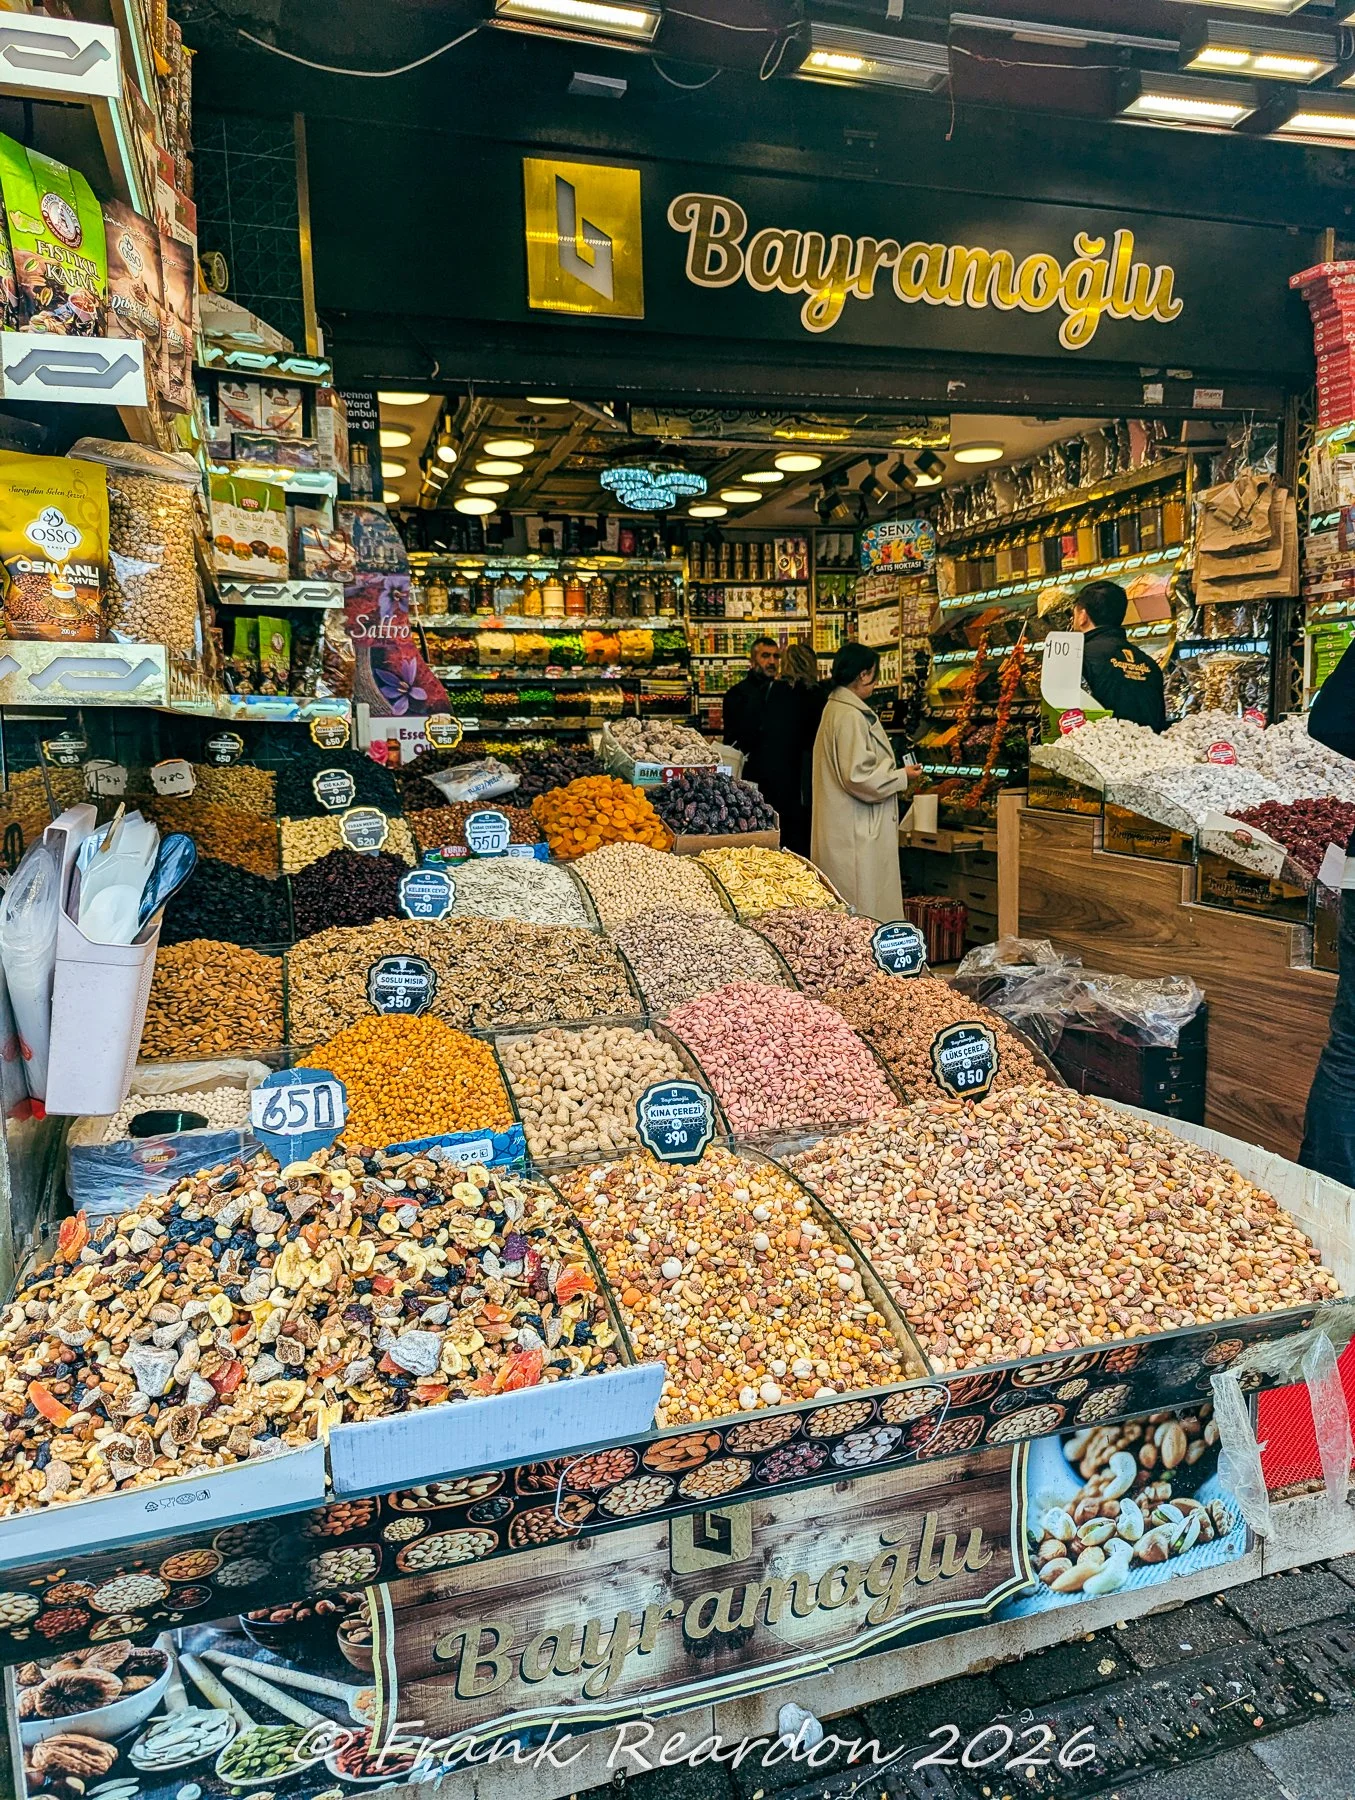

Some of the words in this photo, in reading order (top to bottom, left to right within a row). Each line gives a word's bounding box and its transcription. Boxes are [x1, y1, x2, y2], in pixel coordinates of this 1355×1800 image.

[667, 193, 1182, 350] Bayramoğlu
[346, 400, 370, 409] Ward
[362, 420, 375, 430] Oil
[9, 485, 44, 497] Saraydan
[46, 488, 65, 496] Gelen
[31, 528, 77, 544] OSSO
[880, 522, 916, 537] SENX
[16, 560, 99, 579] OSMANLI
[876, 564, 893, 573] SATIŞ
[351, 614, 411, 640] Saffro
[399, 728, 426, 740] Esse
[215, 754, 231, 763] 650
[329, 794, 347, 805] 780
[357, 837, 376, 846] 520
[471, 834, 500, 850] 550
[414, 902, 433, 913] 730
[893, 955, 912, 968] 490
[381, 976, 403, 984] SOSLU
[404, 977, 424, 985] MISIR
[386, 995, 412, 1008] 350
[945, 1049, 963, 1061] LÜKS
[963, 1043, 985, 1056] ÇEREZ
[957, 1068, 984, 1086] 850
[262, 1084, 335, 1131] 650
[650, 1108, 671, 1118] KINA
[672, 1105, 701, 1117] ÇEREZİ
[664, 1130, 688, 1147] 390
[434, 1511, 996, 1701] Bayramoğlu
